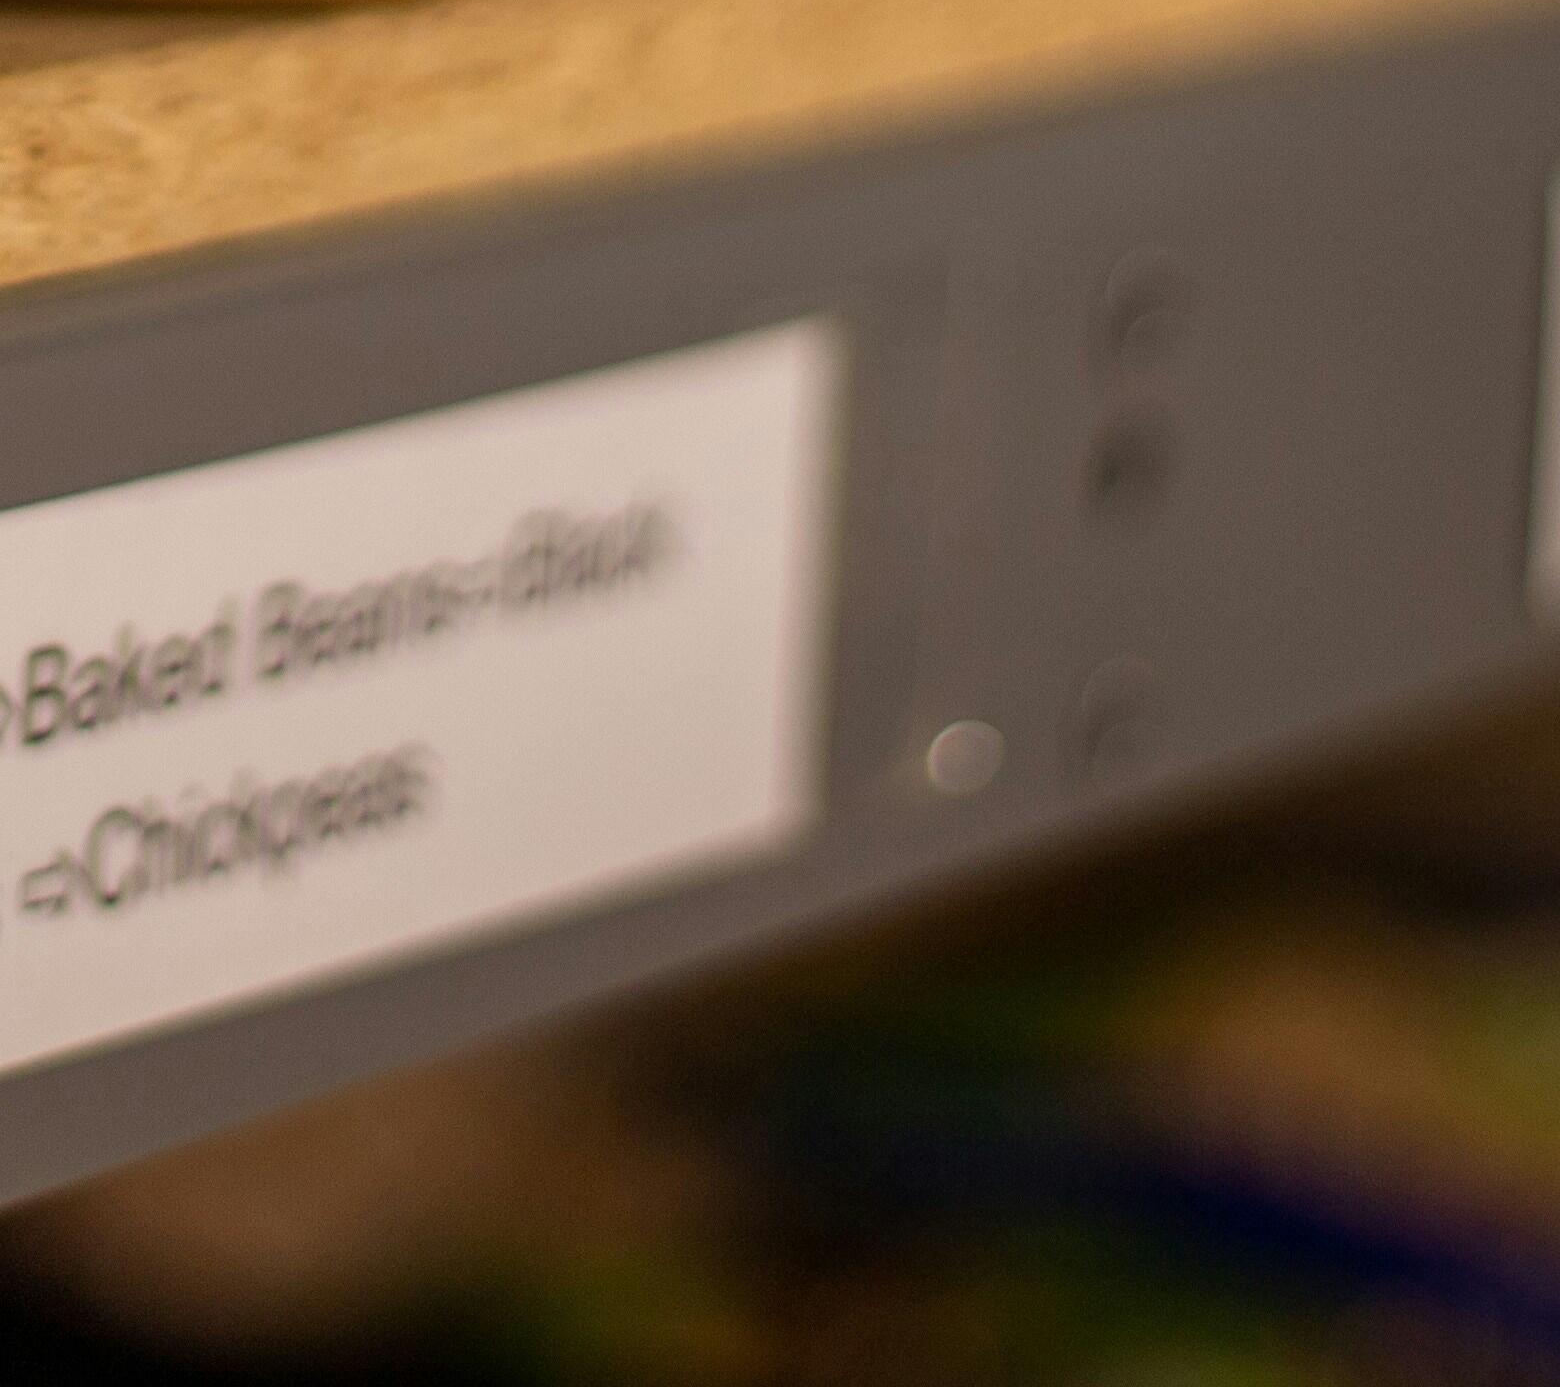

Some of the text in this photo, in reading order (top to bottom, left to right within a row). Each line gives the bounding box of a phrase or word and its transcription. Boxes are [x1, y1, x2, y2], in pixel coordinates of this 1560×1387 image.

[20, 592, 238, 748] Baked
[254, 563, 460, 683] Beans
[84, 739, 438, 909] Chickpeas
